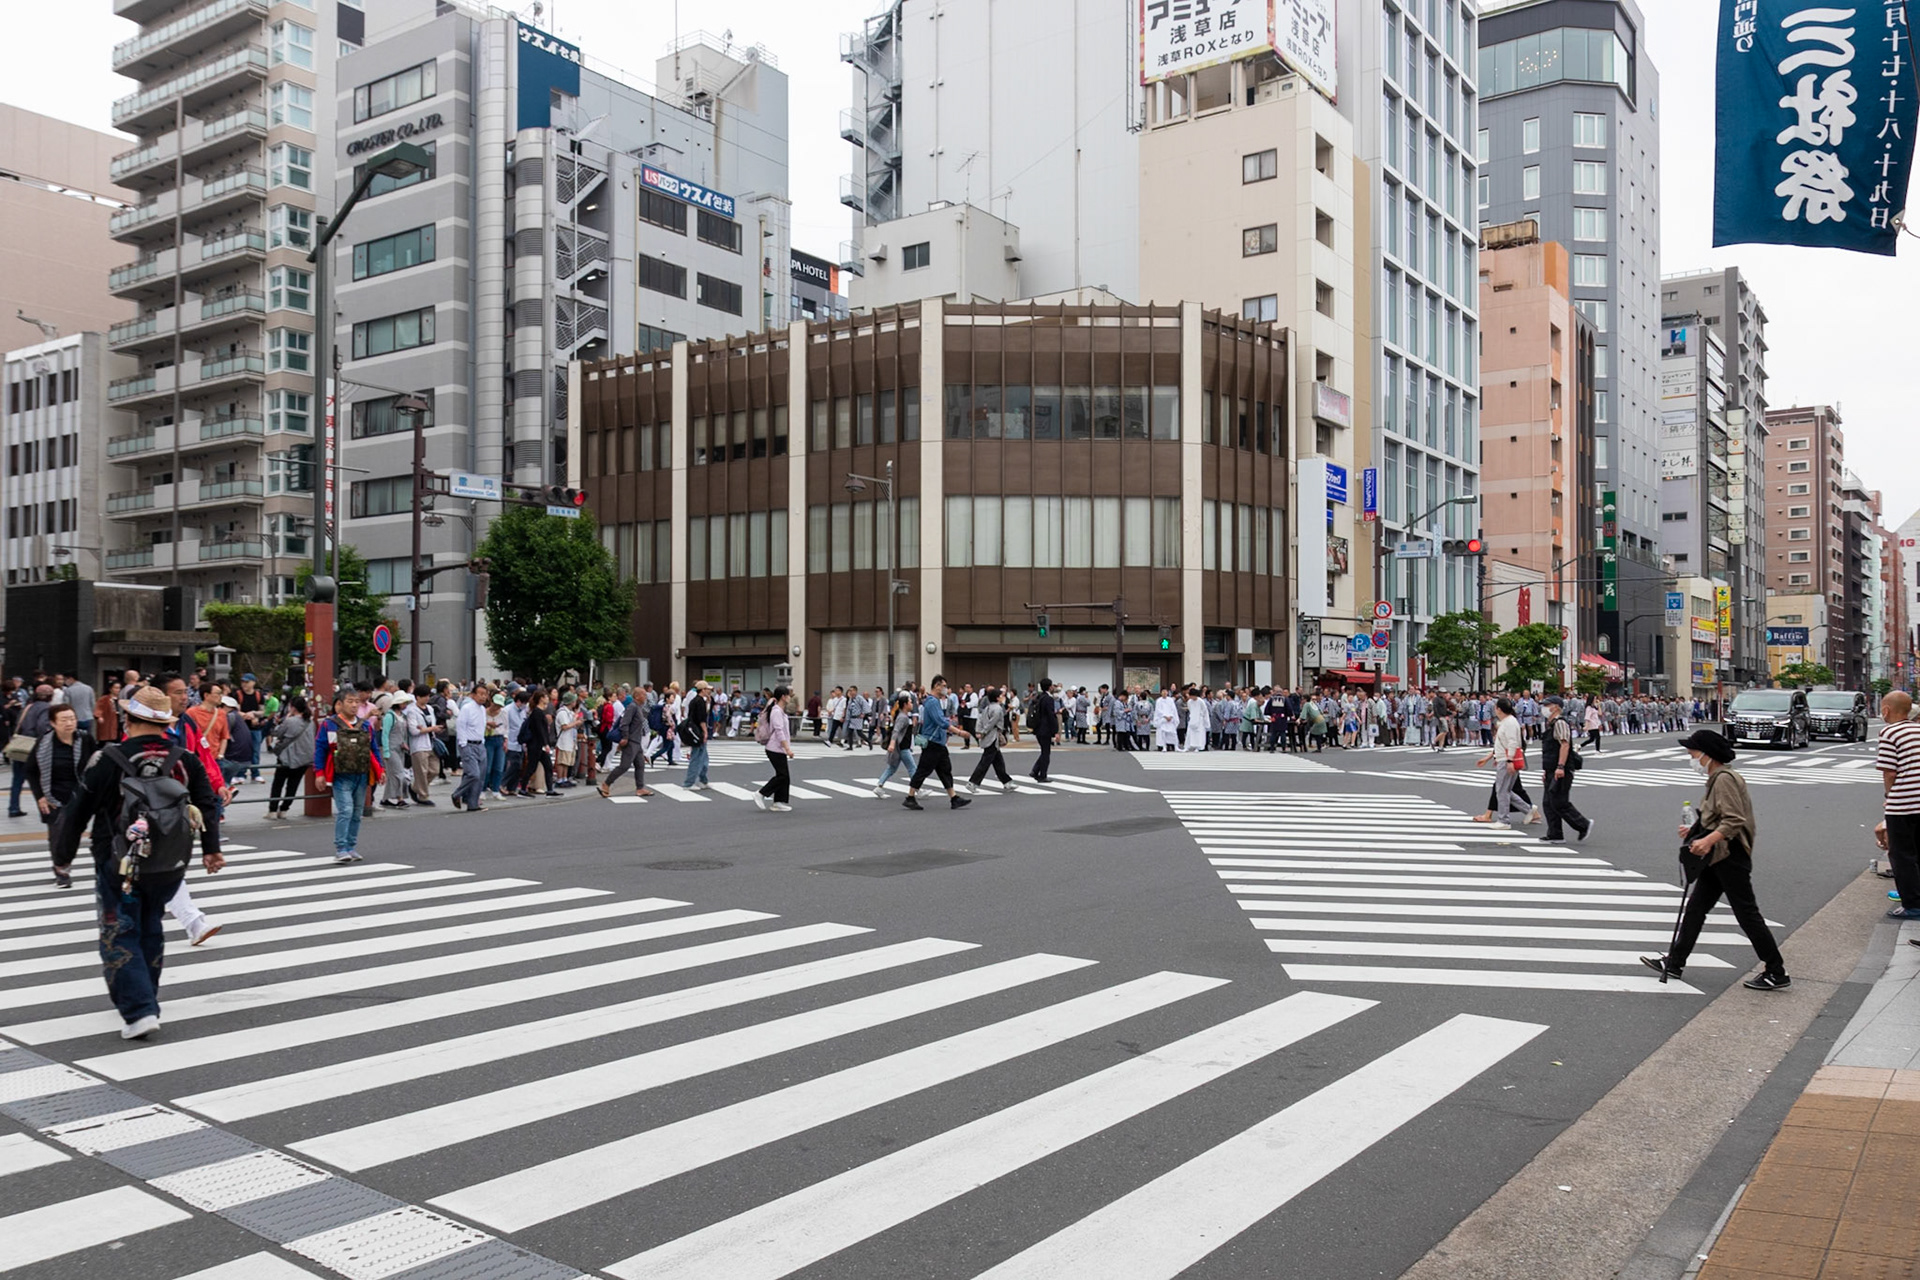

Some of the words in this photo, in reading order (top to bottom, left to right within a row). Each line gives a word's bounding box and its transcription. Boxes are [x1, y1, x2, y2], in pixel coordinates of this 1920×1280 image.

[1170, 10, 1237, 45] 浅草店
[1291, 16, 1319, 57] 浅草店
[1157, 30, 1254, 67] 浅草ROXとなり
[679, 182, 733, 214] ウスイ包装
[802, 263, 829, 281] HOTEL
